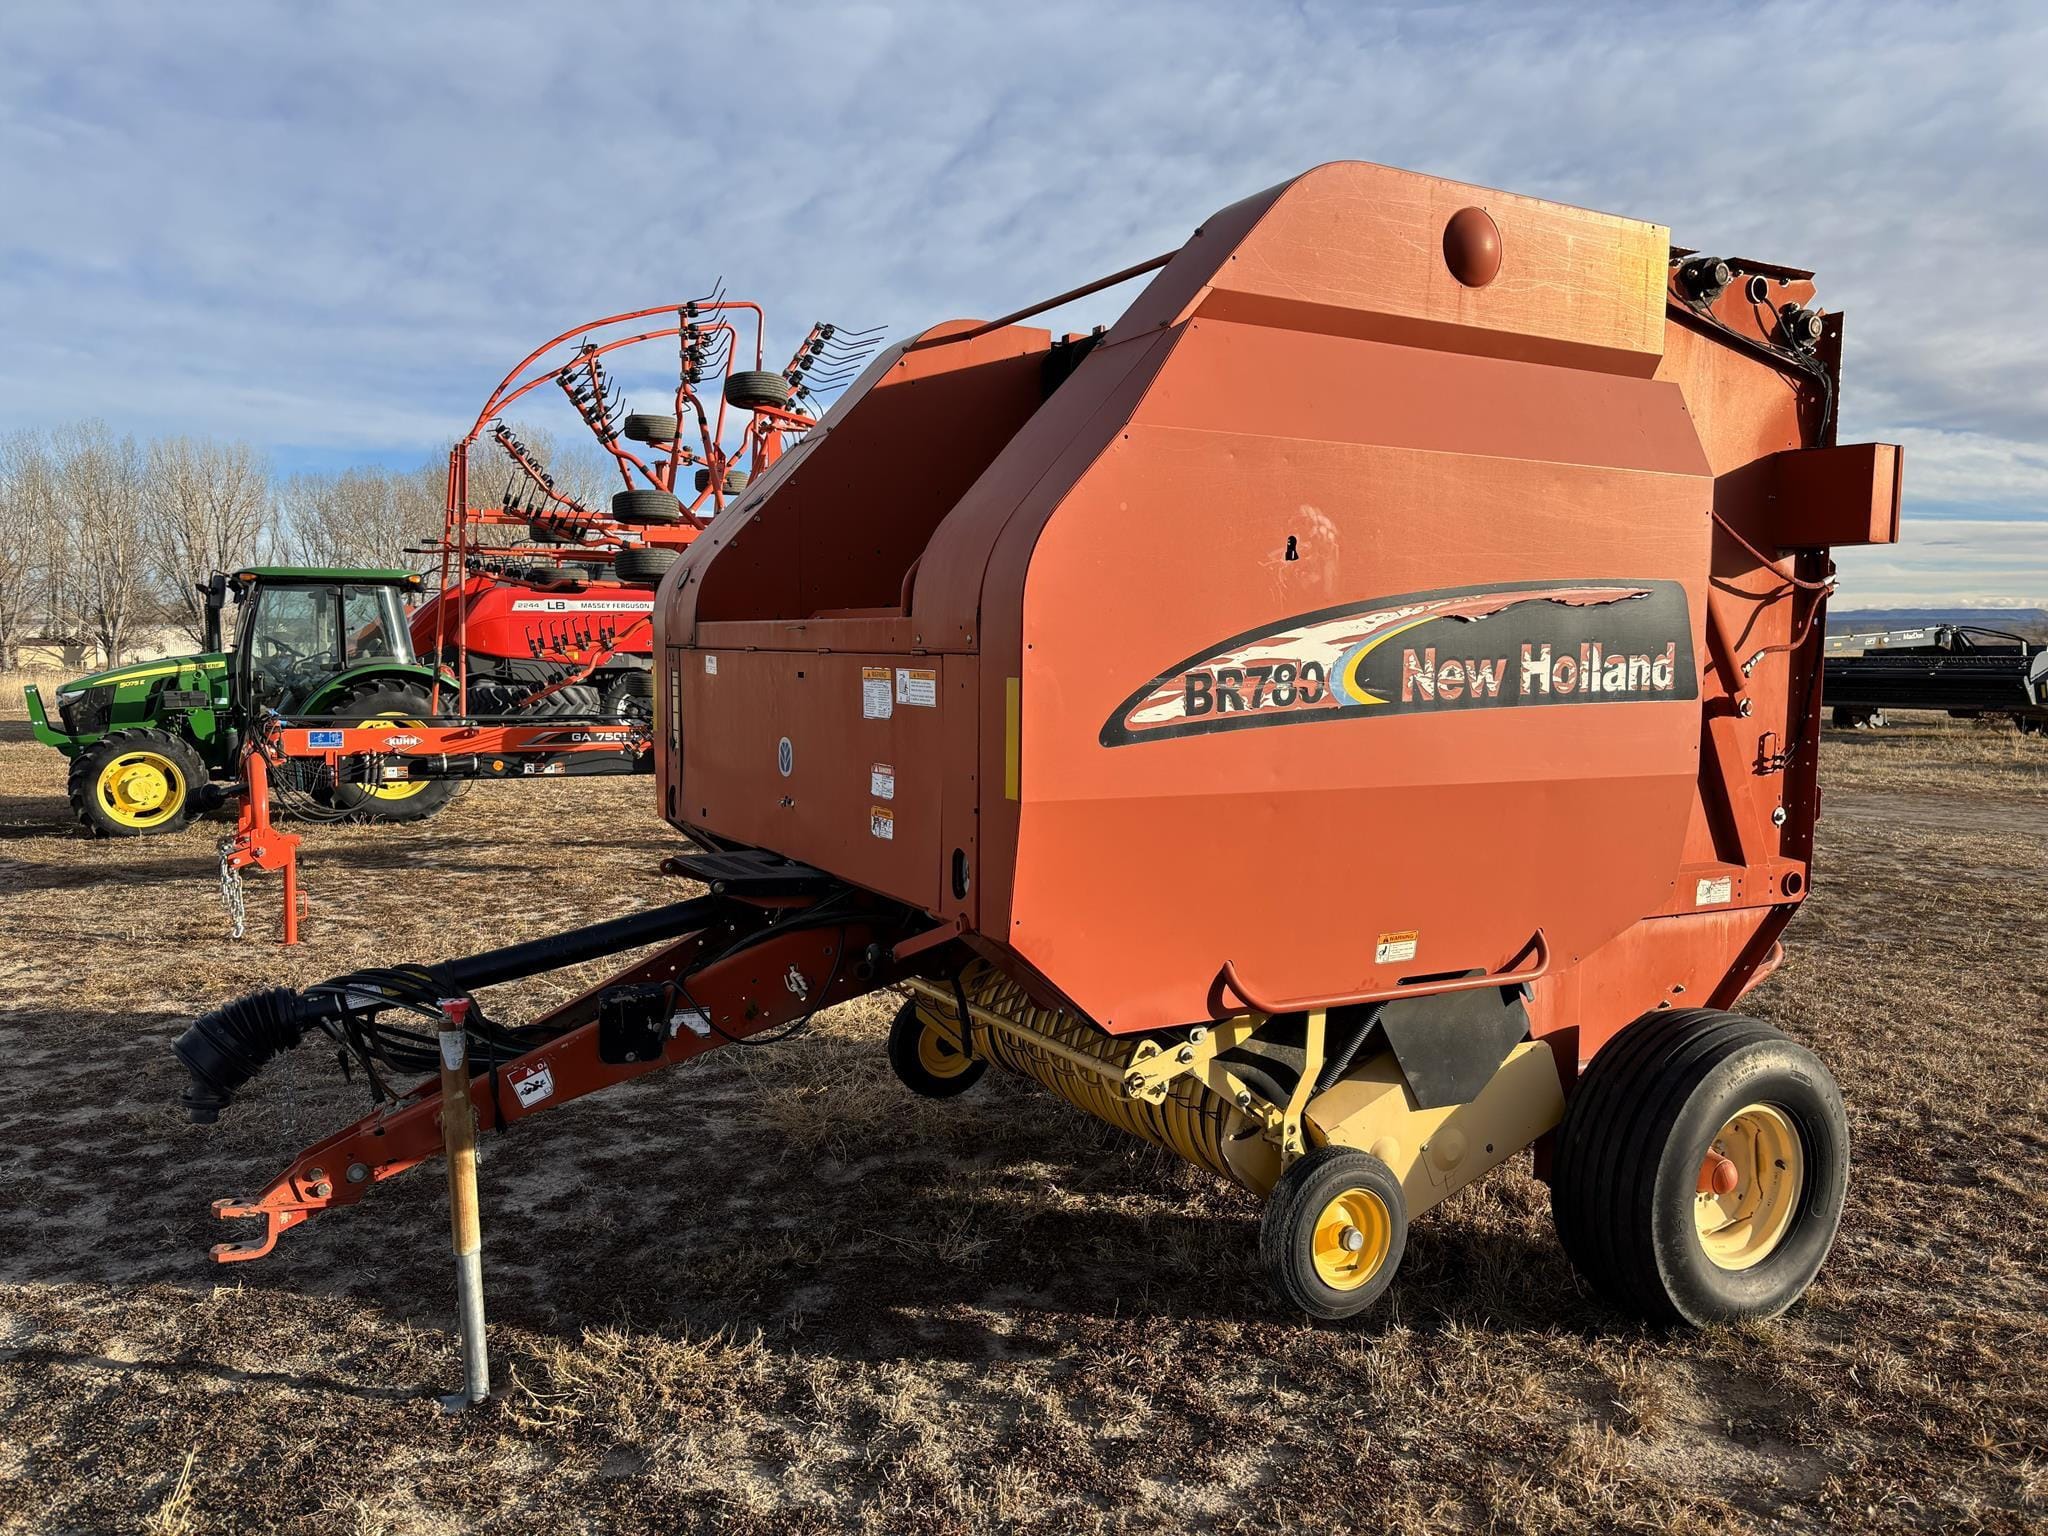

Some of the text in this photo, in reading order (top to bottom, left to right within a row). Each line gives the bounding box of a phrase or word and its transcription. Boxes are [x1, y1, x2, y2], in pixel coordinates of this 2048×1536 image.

[547, 602, 566, 610] LB
[1903, 632, 1924, 640] MacDon
[1401, 641, 1676, 702] New Holland
[1184, 661, 1325, 717] BR780
[571, 733, 592, 741] GA
[389, 737, 417, 746] KUHN
